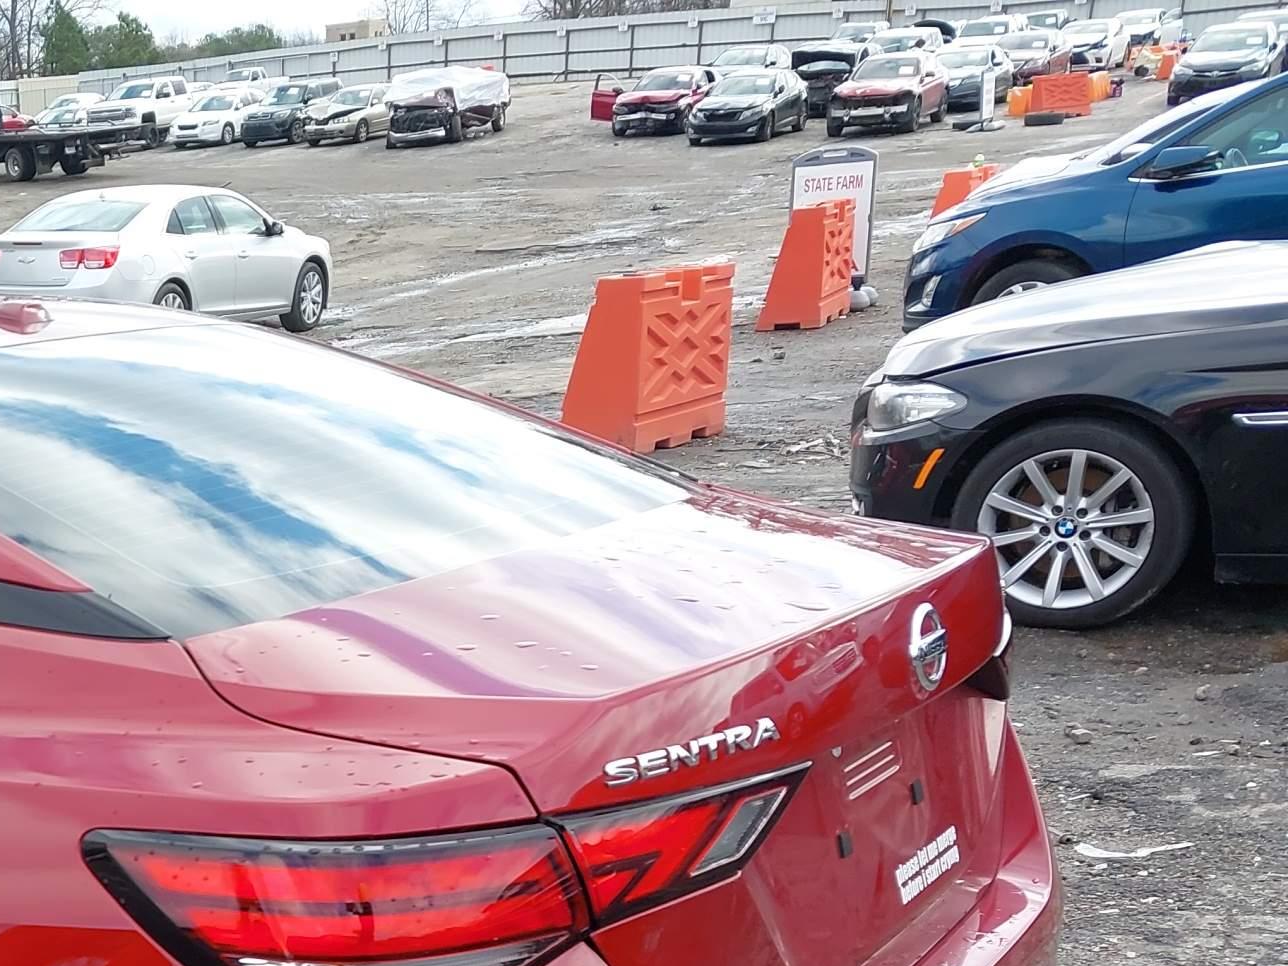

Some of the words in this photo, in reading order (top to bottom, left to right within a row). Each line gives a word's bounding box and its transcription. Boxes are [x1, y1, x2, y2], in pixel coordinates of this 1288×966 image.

[804, 176, 834, 193] STATE
[836, 174, 864, 190] FARM
[603, 716, 781, 787] SENTRA
[900, 875, 924, 905] before
[925, 858, 942, 885] start
[939, 845, 960, 873] crying
